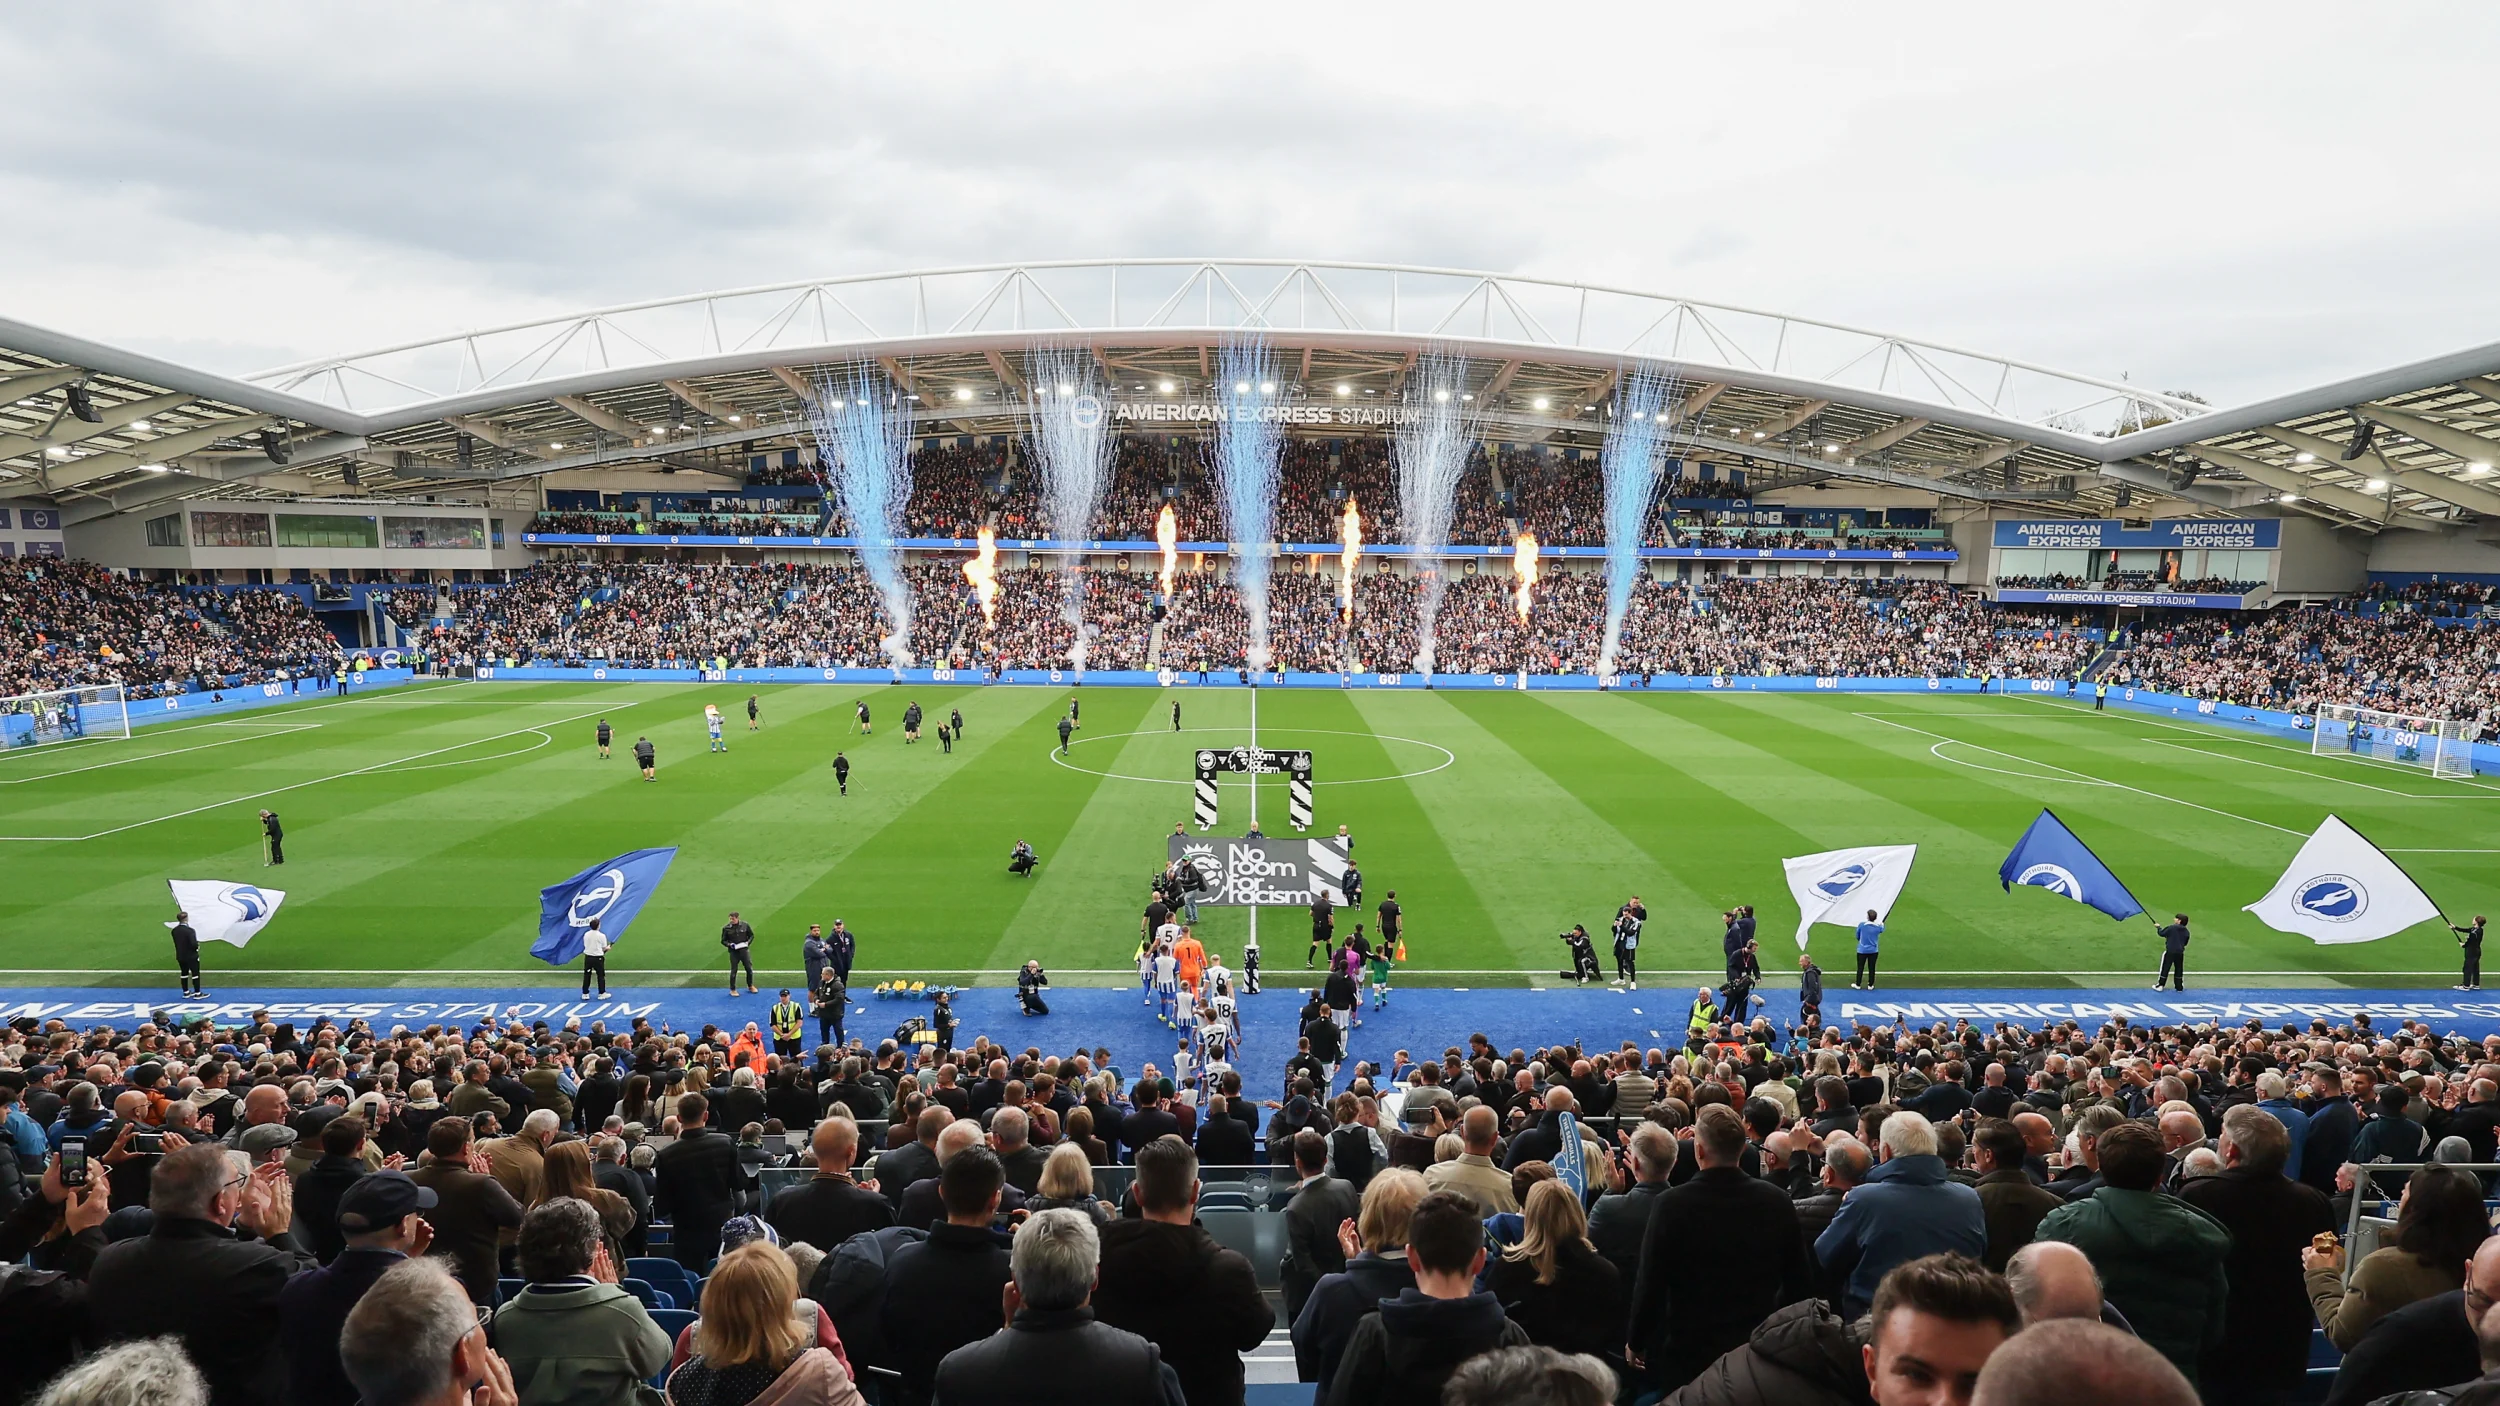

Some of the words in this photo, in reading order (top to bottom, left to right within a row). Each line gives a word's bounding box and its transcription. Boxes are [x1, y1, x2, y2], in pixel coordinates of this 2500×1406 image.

[1116, 404, 1228, 422] AMERICAN
[1236, 406, 1332, 424] EXPRESS
[1340, 407, 1421, 425] STADIUM
[2017, 524, 2101, 536] AMERICAN
[2170, 523, 2255, 536] AMERICAN
[596, 534, 611, 543] GO!
[739, 536, 753, 544] GO!
[2028, 536, 2101, 548] EXPRESS
[2182, 536, 2255, 547] EXPRESS
[1758, 550, 1772, 558] GO!
[2046, 592, 2102, 602] AMERICAN
[2104, 594, 2154, 604] EXPRESS
[2156, 596, 2196, 605] STADIUM
[706, 670, 727, 680] GO!
[932, 670, 954, 681] GO!
[1379, 674, 1400, 685] GO!
[1599, 676, 1620, 686] GO!
[1816, 677, 1838, 688] GO!
[2031, 680, 2054, 692] GO!
[263, 683, 284, 698] GO!
[2198, 700, 2216, 714] GO!
[1250, 746, 1264, 754] No
[1250, 753, 1276, 761] room
[1250, 760, 1264, 768] for
[1250, 764, 1280, 774] racism
[1229, 844, 1266, 862] No
[1229, 860, 1296, 876] room
[1228, 874, 1264, 891] for
[1229, 885, 1312, 904] racism
[1165, 930, 1172, 942] 5
[1186, 947, 1191, 959] 1
[1216, 972, 1224, 985] 6
[0, 1002, 75, 1018] N
[60, 1002, 398, 1018] EXPRESS
[391, 1002, 663, 1018] STADIUM
[1217, 1004, 1231, 1018] 18
[1840, 1003, 2169, 1018] AMERICAN
[2164, 1003, 2460, 1018] EXPRESS
[1208, 1032, 1224, 1048] 27
[1566, 1130, 1576, 1164] SEAGULLS
